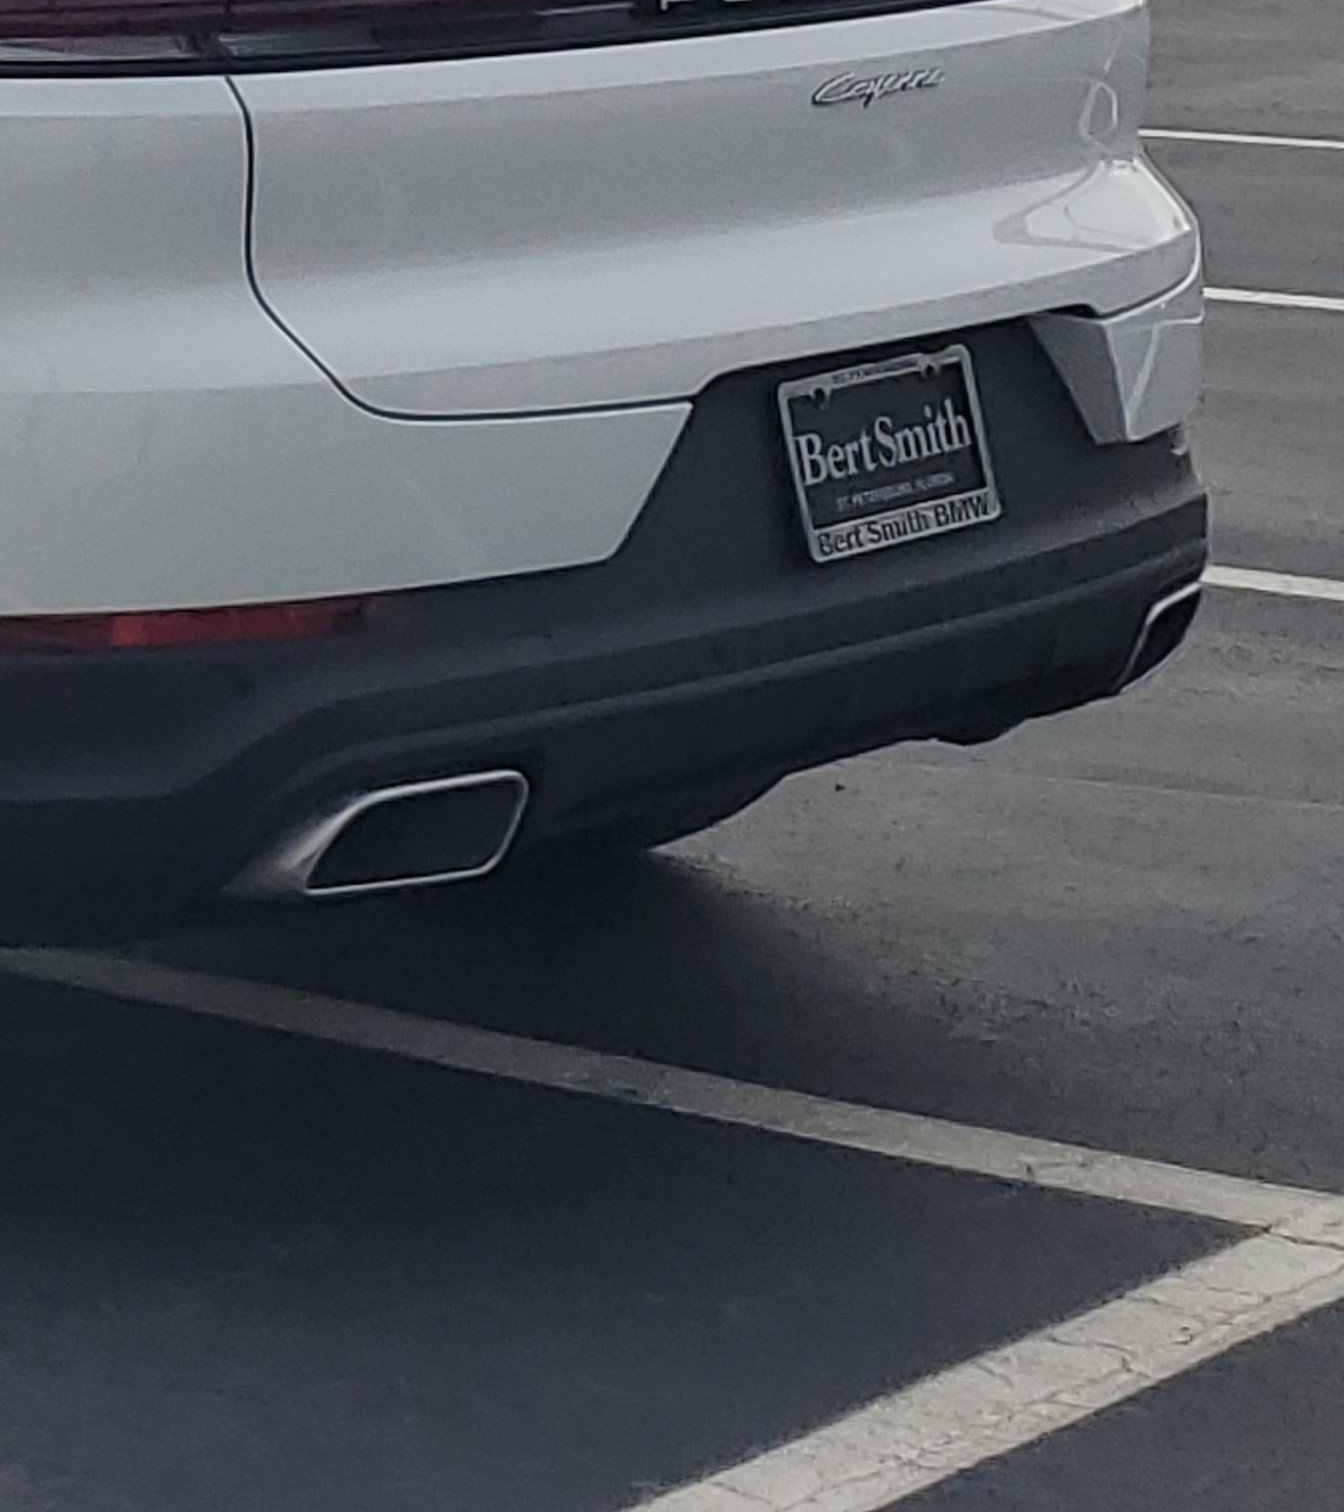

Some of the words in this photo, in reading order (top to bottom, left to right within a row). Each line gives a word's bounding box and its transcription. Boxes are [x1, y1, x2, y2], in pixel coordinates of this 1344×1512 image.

[795, 430, 876, 486] Bert
[874, 398, 971, 468] Smith
[817, 526, 863, 556] Bert
[934, 492, 989, 527] BMW
